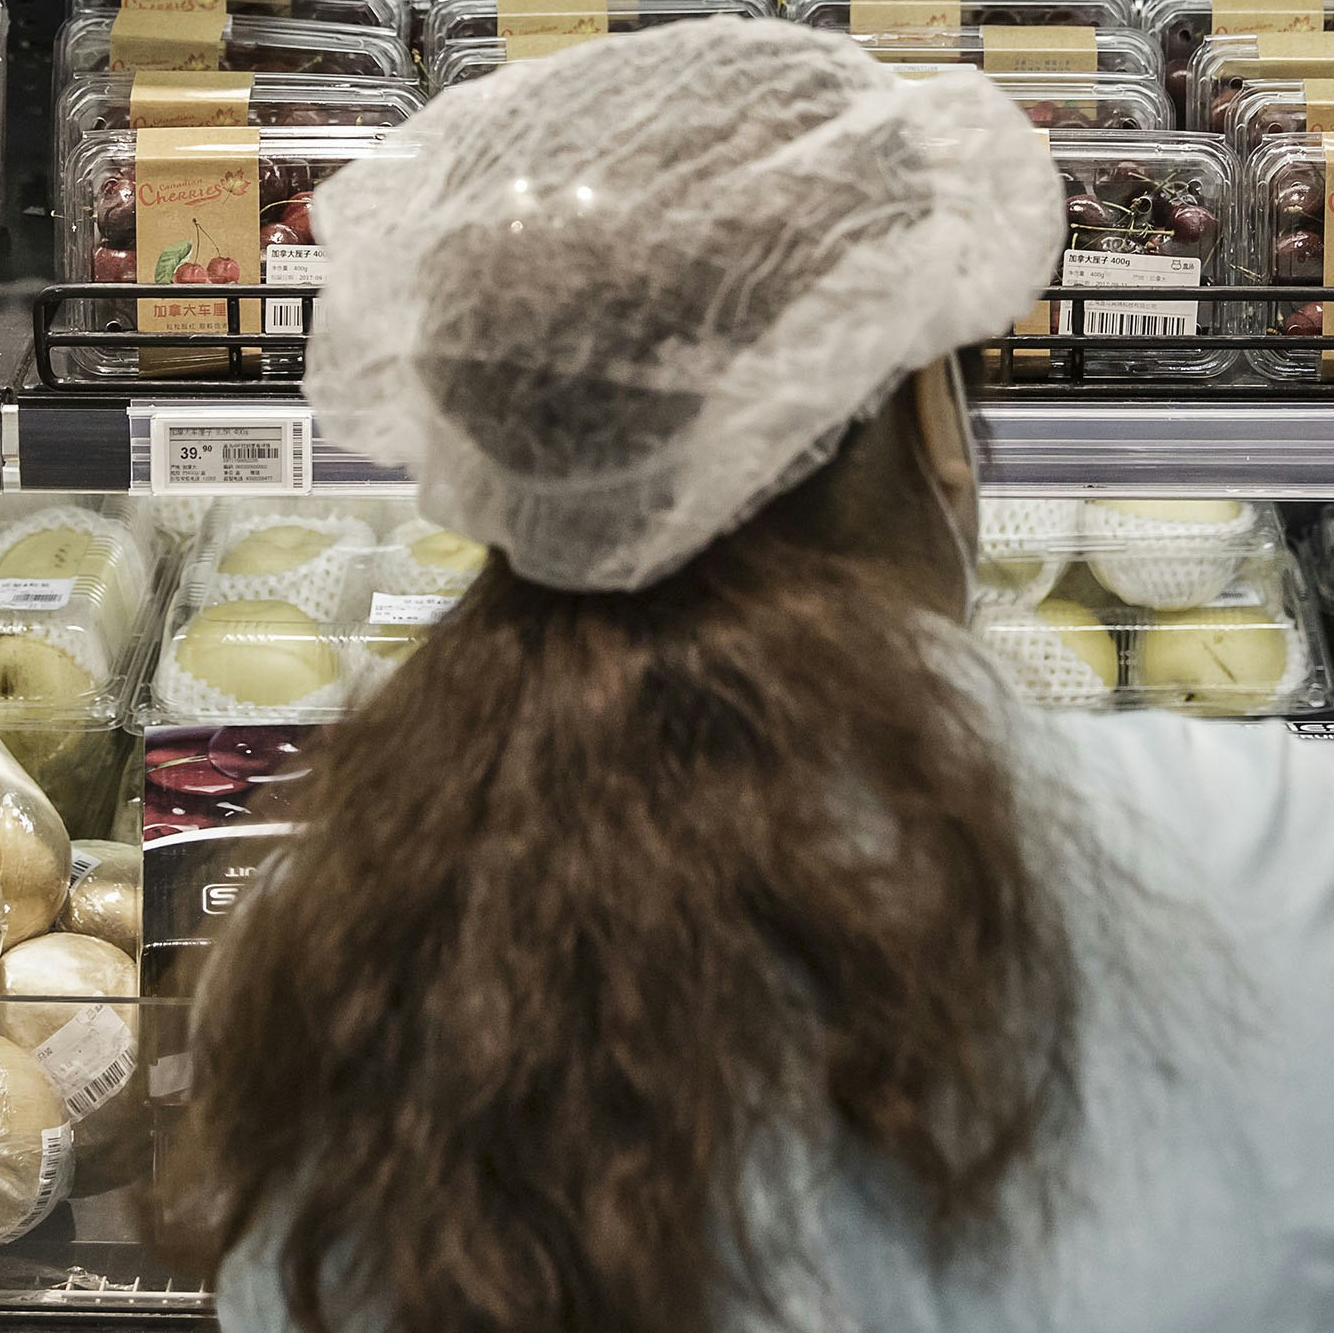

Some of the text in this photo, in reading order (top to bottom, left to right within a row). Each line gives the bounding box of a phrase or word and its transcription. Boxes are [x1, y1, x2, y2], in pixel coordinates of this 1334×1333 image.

[159, 178, 203, 191] Canadian
[138, 183, 222, 207] Cherries
[271, 249, 311, 259] 加拿大厘子
[1069, 254, 1108, 265] 加拿大厘子
[1110, 256, 1131, 267] 400g
[153, 304, 227, 318] 加拿大车厘
[180, 445, 213, 460] 39.90
